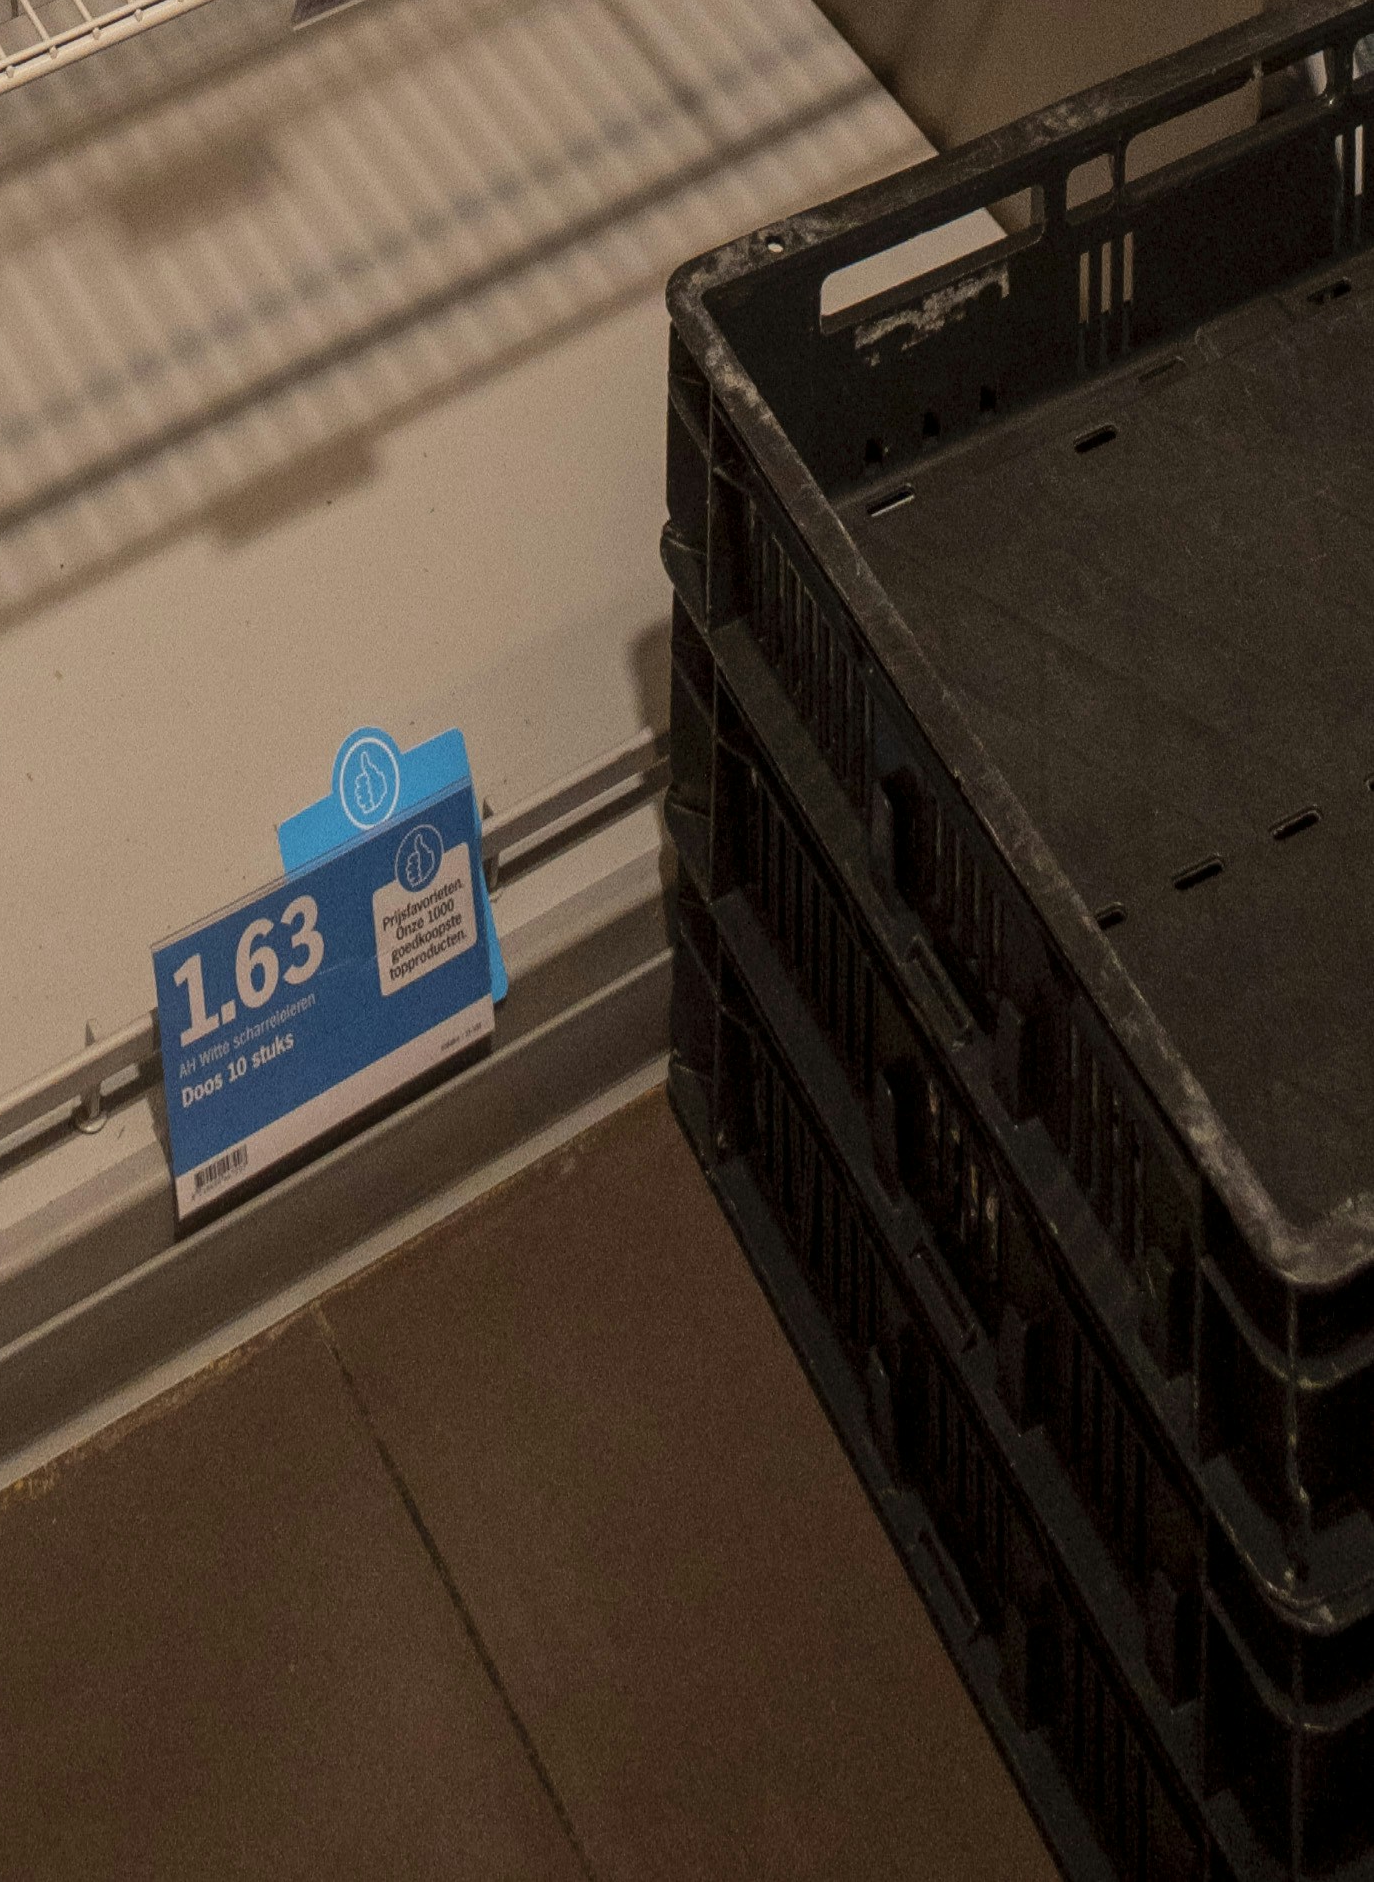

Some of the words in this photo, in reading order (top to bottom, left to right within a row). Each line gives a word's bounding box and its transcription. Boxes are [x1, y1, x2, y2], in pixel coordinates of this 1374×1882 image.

[391, 914, 462, 965] goedkoopste
[395, 916, 424, 942] Onze
[428, 898, 455, 925] 1000
[173, 895, 325, 1048] 1.63
[180, 1057, 196, 1079] AH
[199, 1041, 230, 1066] Witte
[233, 993, 316, 1049] scharreleieren
[182, 1073, 224, 1108] Doos
[227, 1056, 247, 1083] 10
[252, 1033, 295, 1070] stuks
